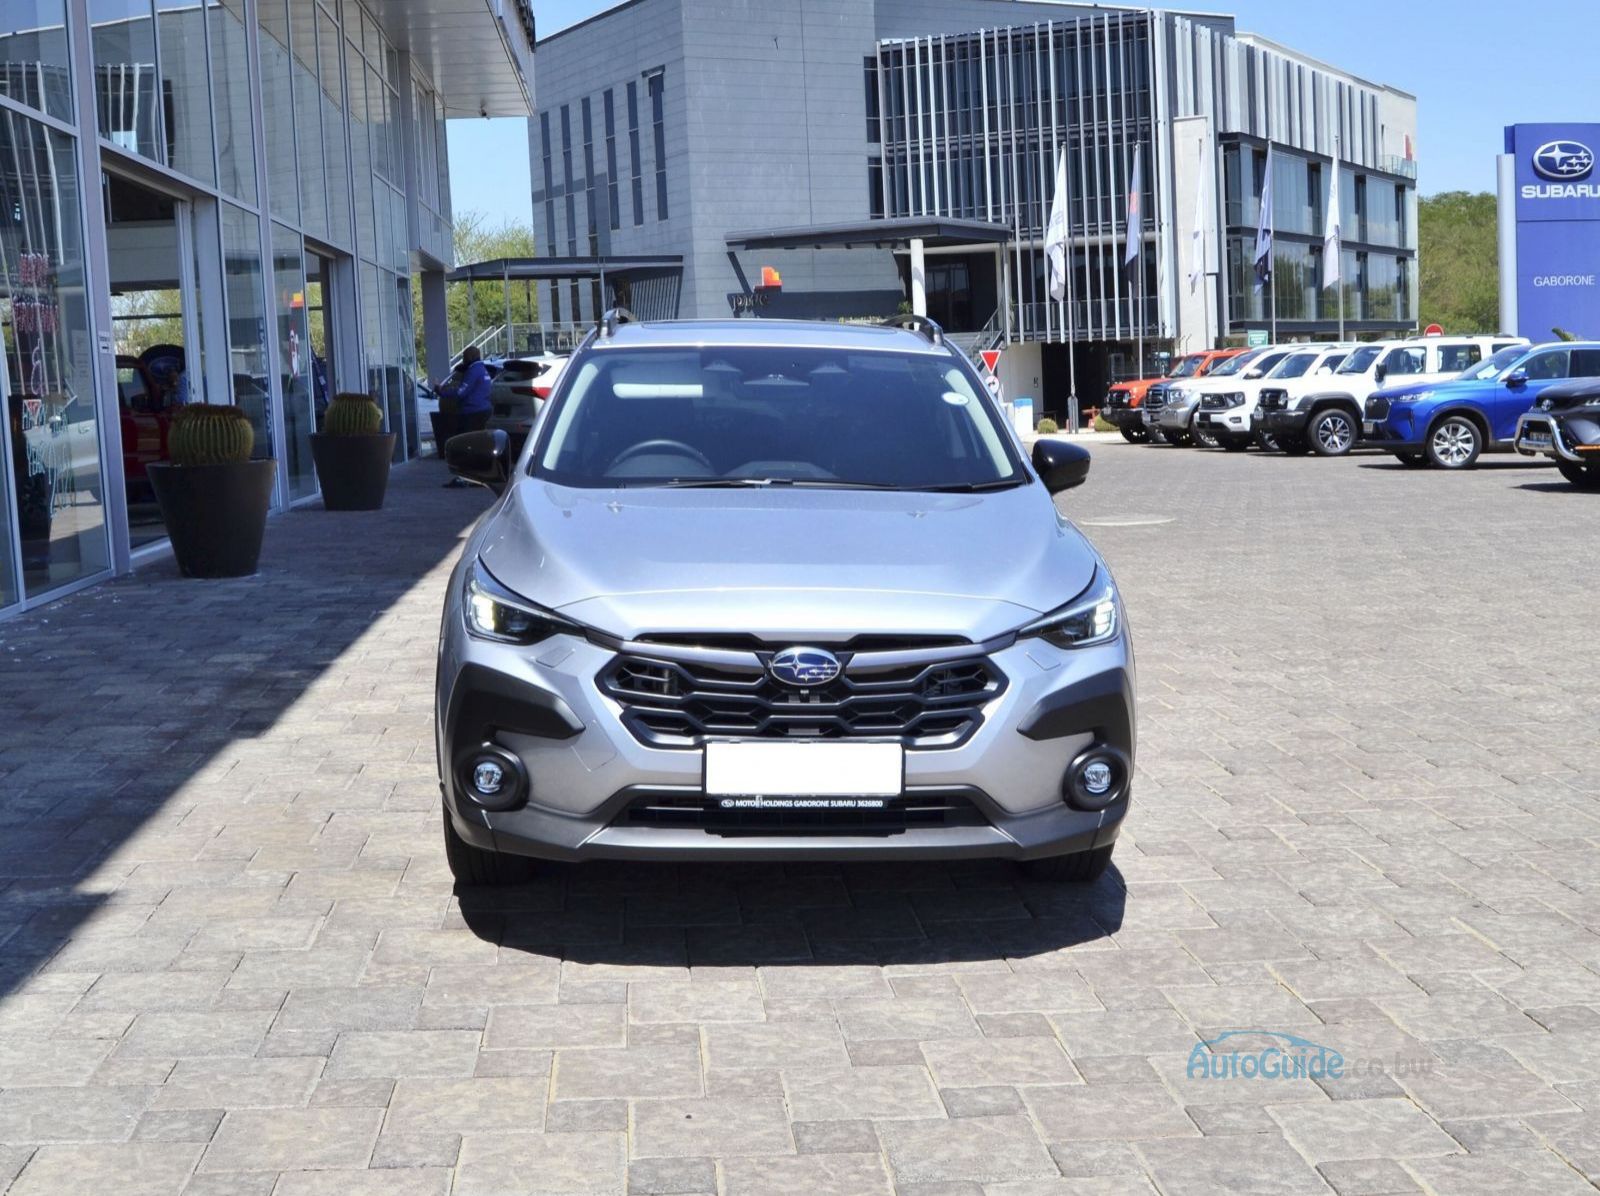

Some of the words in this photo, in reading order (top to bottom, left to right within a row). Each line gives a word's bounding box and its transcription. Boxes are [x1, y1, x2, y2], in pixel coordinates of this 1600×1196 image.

[1521, 184, 1600, 198] SUBARU
[1533, 274, 1595, 287] GABORONE
[793, 799, 829, 808] GABORONE
[830, 799, 856, 808] SUBARU
